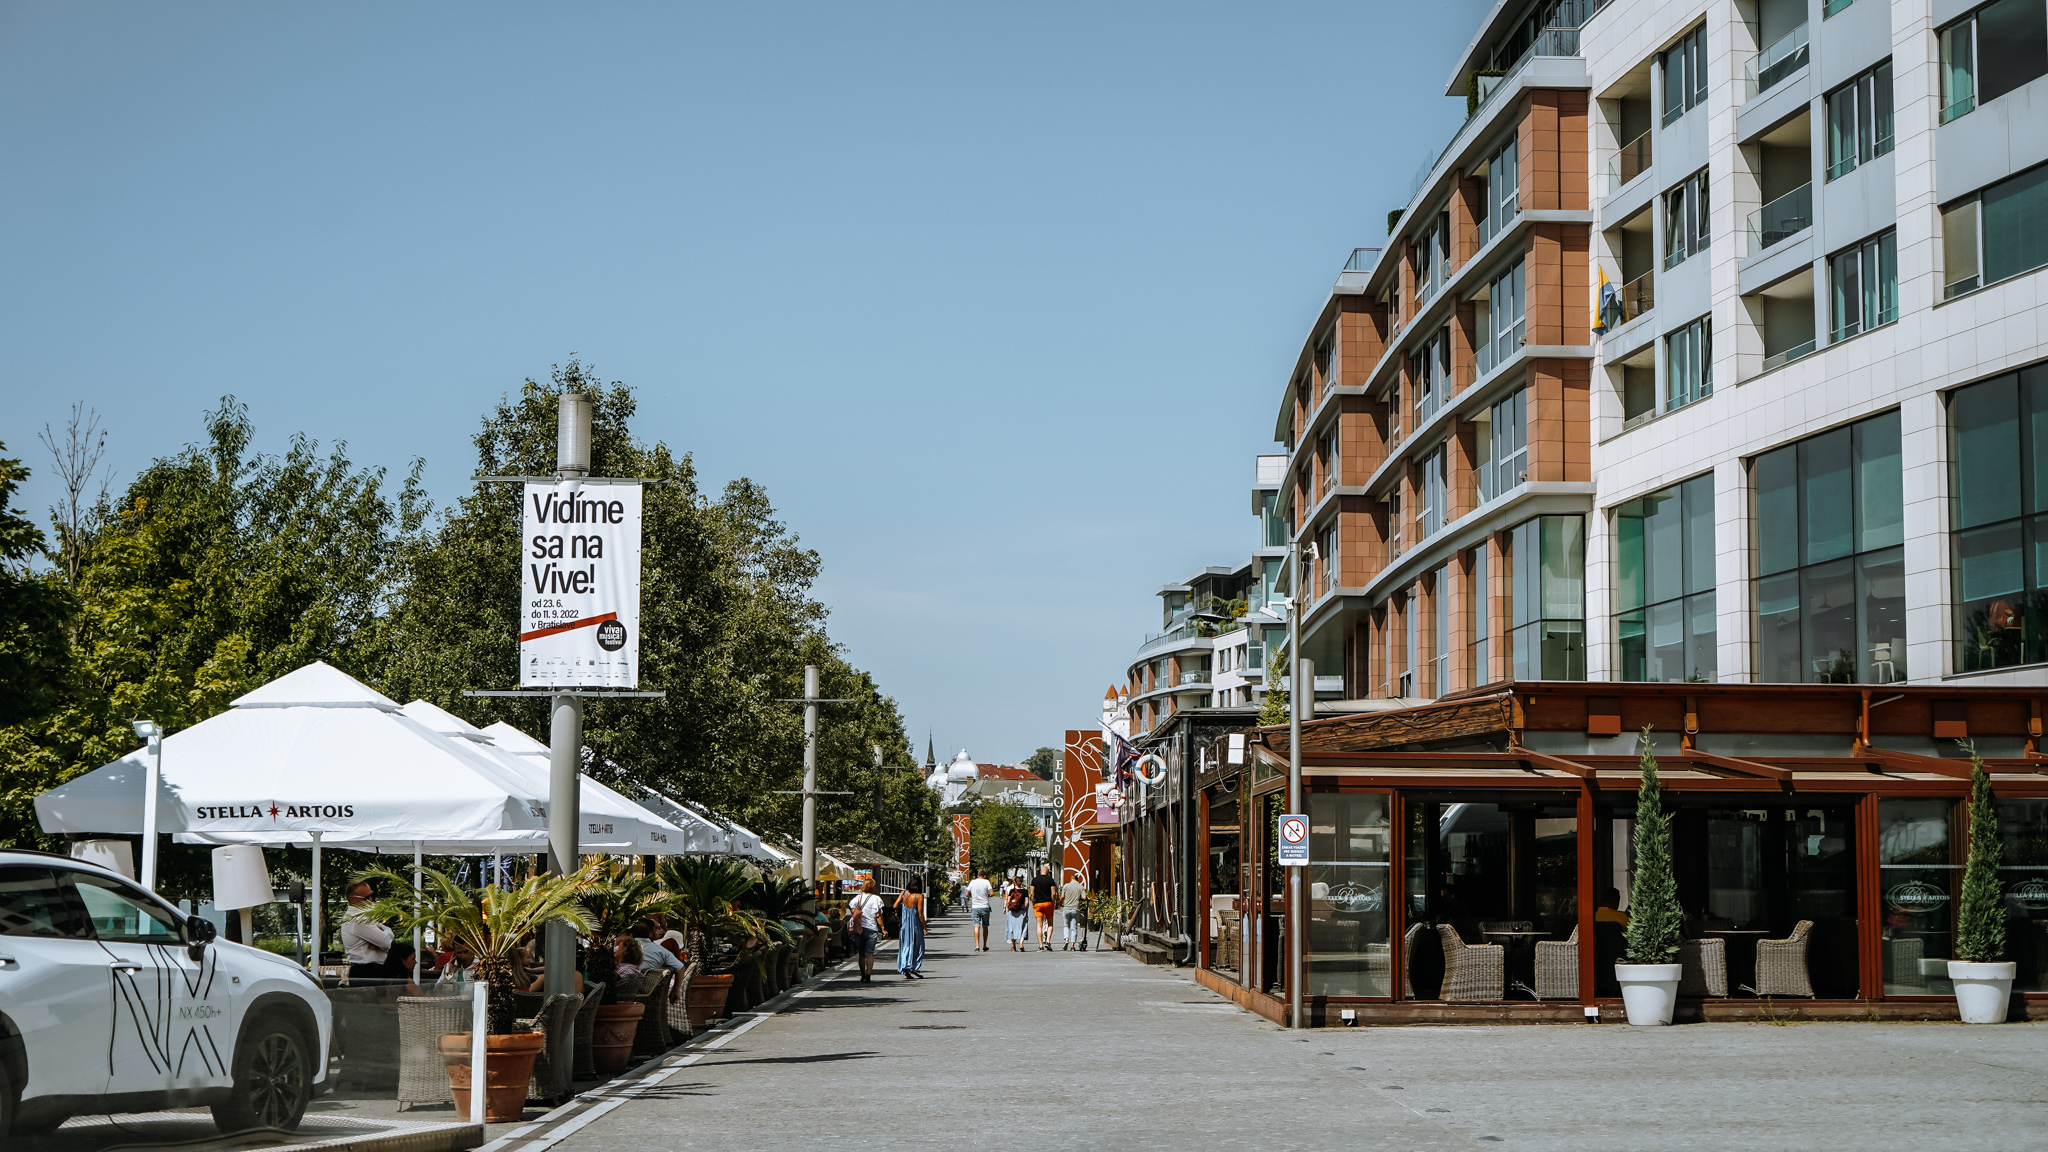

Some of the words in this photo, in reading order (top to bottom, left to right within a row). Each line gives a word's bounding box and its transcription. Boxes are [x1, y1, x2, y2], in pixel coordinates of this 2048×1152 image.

[532, 491, 624, 525] Vidíme
[531, 535, 563, 559] sa
[572, 535, 603, 559] na
[530, 562, 595, 594] Vive!
[531, 599, 542, 608] od
[543, 599, 555, 608] 23.
[556, 599, 564, 608] 6.
[531, 609, 542, 619] do
[543, 610, 551, 619] 11.
[552, 610, 559, 619] 9.
[560, 610, 579, 619] 2022
[537, 620, 576, 630] Bratislave
[604, 624, 620, 634] viva
[1052, 759, 1065, 846] EUROVEA
[196, 805, 264, 819] STELLA
[285, 804, 354, 818] ARTOIS
[179, 1006, 193, 1019] NX
[194, 1005, 222, 1019] 450h+
